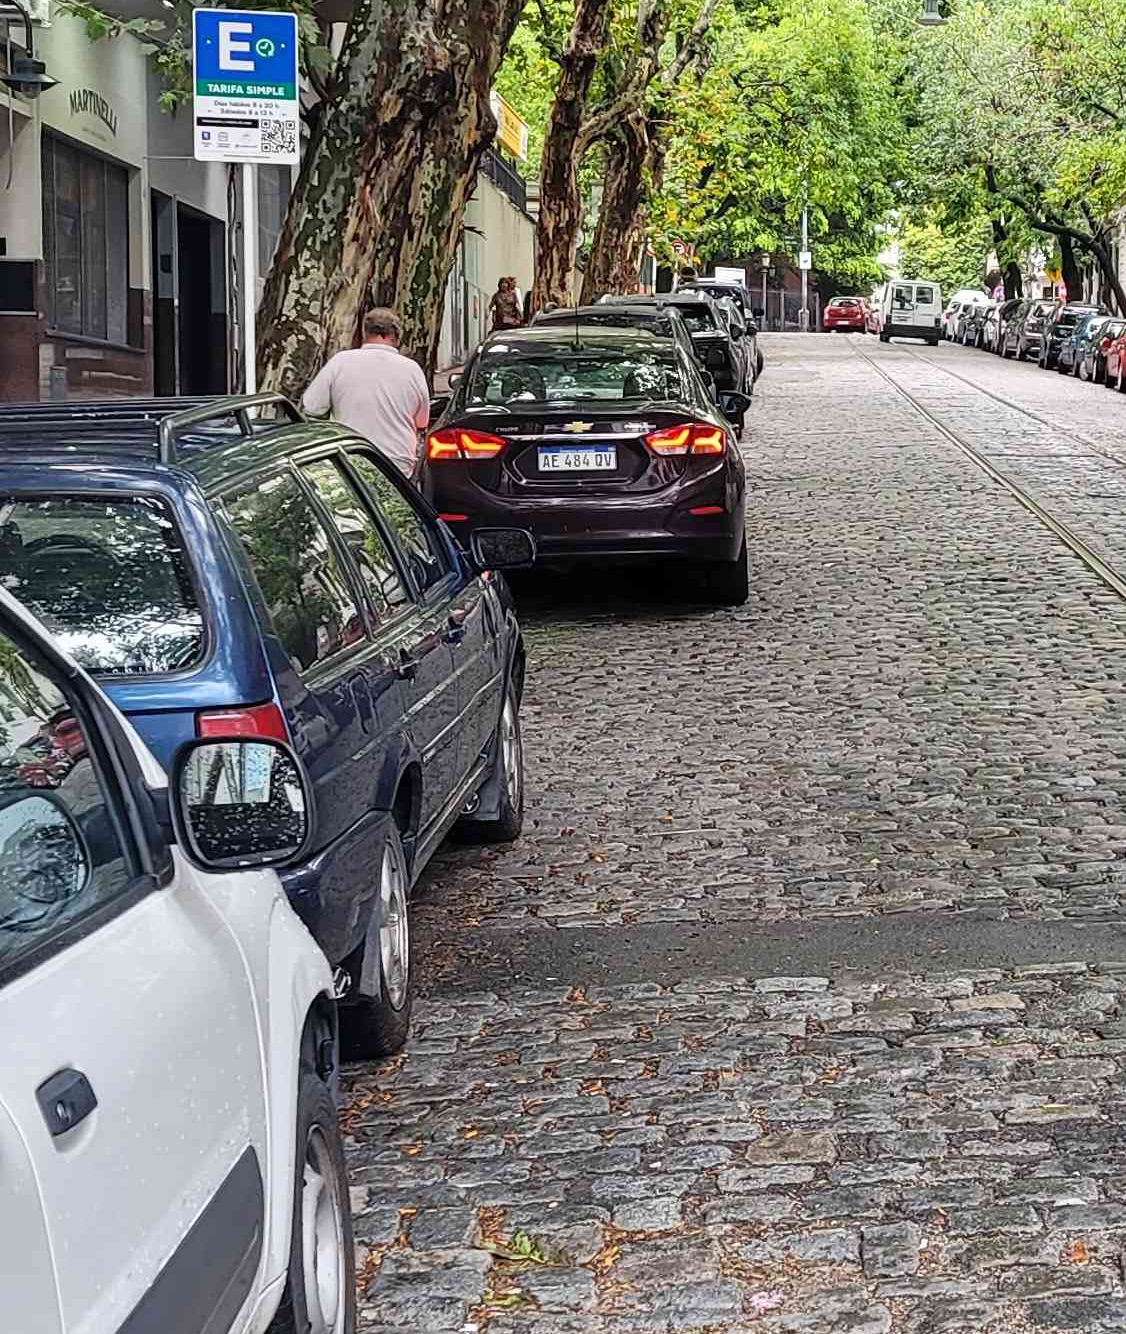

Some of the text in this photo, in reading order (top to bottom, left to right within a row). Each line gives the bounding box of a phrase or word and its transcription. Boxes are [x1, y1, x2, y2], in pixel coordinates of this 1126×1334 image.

[218, 21, 255, 72] E
[207, 83, 285, 96] TARIFA SIMPLE
[69, 88, 118, 137] MARTINELLI
[542, 453, 612, 468] AE 484 QV
